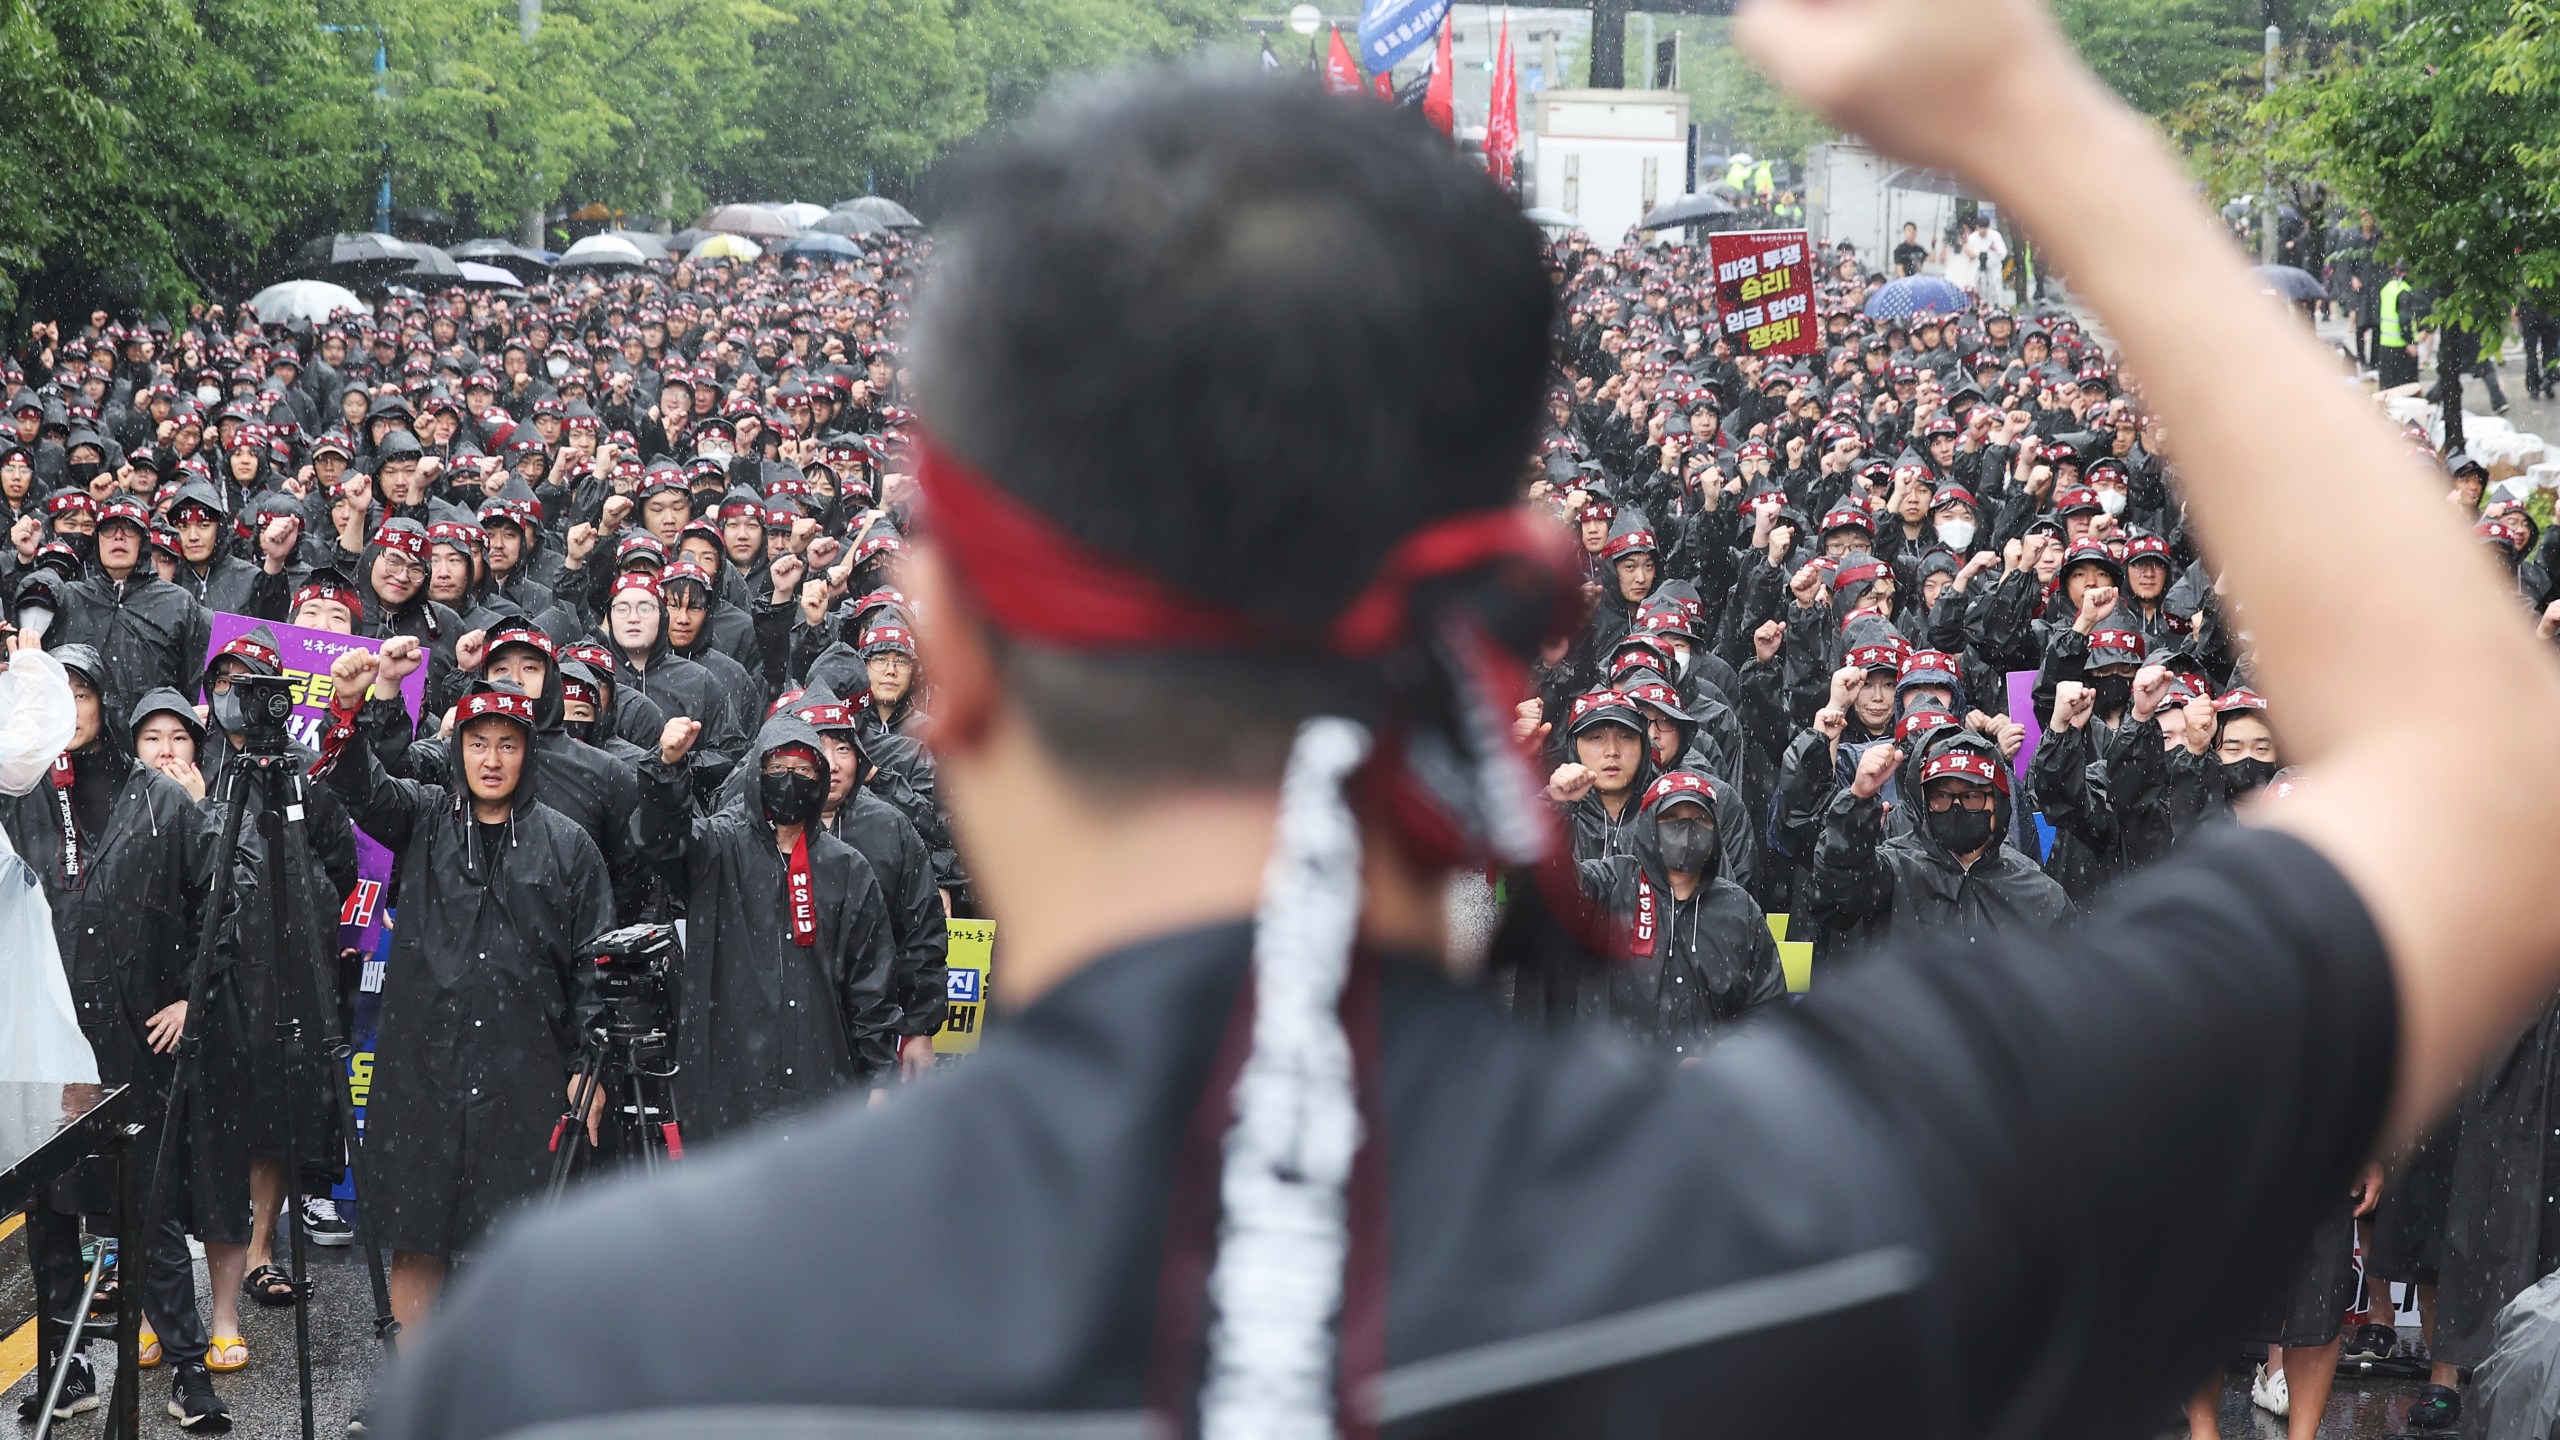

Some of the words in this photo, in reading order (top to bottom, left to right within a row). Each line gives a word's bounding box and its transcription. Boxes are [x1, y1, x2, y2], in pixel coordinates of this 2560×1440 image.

[1719, 256, 1759, 283] 파업
[1762, 243, 1802, 269] 투쟁
[1740, 268, 1792, 302] 승리!
[1725, 306, 1764, 334] 임금
[1768, 294, 1808, 321] 협약
[1747, 317, 1801, 350] 쟁취!
[469, 694, 534, 716] 총파업
[793, 873, 813, 933] NSEU
[1639, 883, 1652, 940] NSEU
